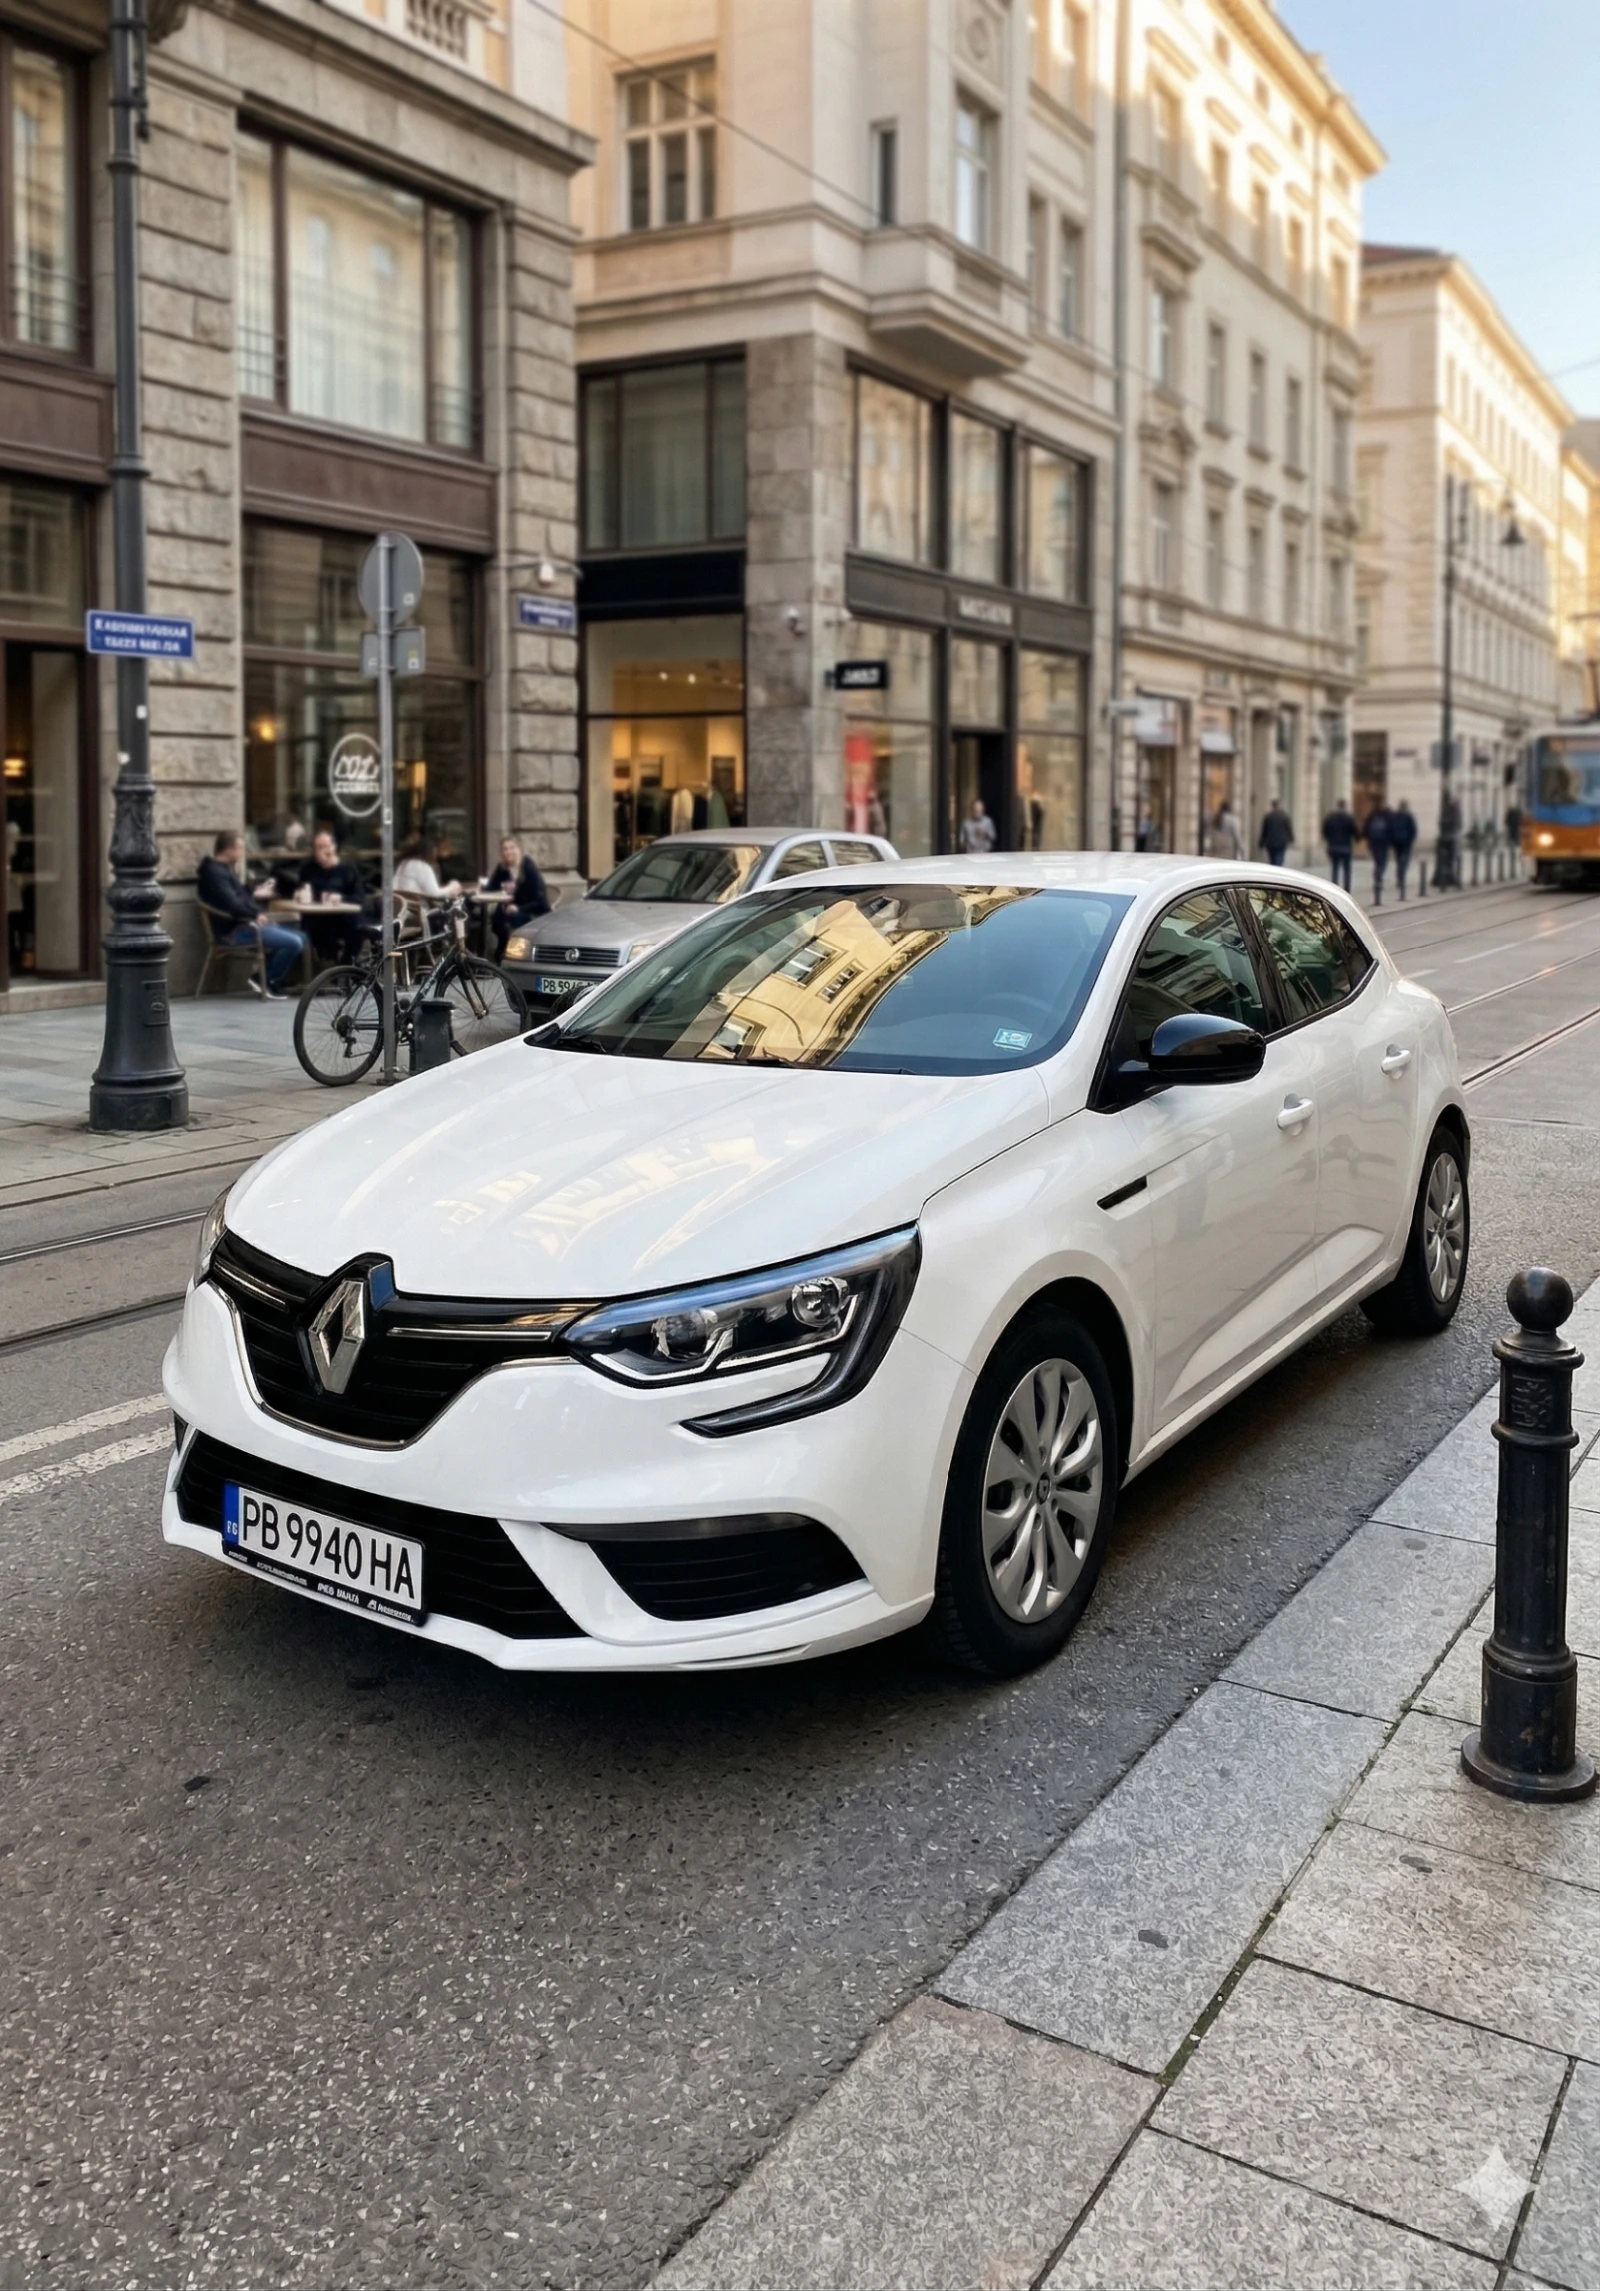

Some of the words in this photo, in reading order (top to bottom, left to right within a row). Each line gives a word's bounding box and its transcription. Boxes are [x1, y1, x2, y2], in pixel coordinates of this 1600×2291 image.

[543, 979, 556, 993] PB
[243, 1495, 280, 1551] PB
[286, 1512, 363, 1580] 9940
[370, 1537, 415, 1600] HA
